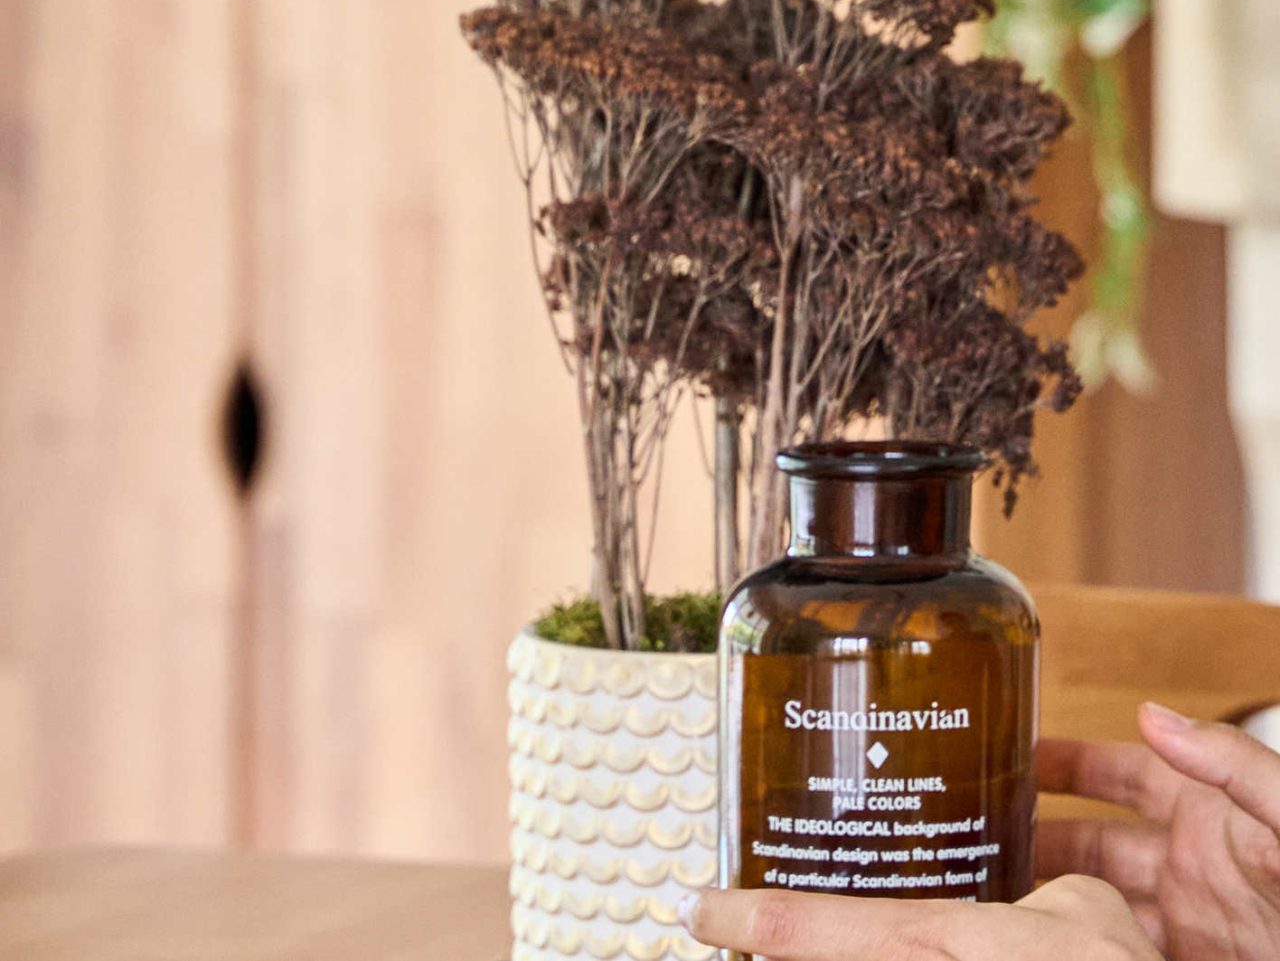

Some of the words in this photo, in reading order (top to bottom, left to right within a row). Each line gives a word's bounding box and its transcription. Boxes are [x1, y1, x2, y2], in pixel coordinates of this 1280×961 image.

[784, 700, 970, 731] Scandinavian
[808, 777, 857, 793] SIMPLE,
[862, 778, 905, 792] CLEAN
[907, 777, 947, 792] LINES,
[832, 796, 865, 811] PALE
[867, 796, 922, 811] COLORS
[767, 815, 793, 833] THE
[794, 818, 891, 837] IDEOLOGICAL
[893, 817, 971, 839] background
[972, 815, 986, 831] of
[752, 840, 830, 861] Scandinavian
[832, 847, 878, 865] design
[880, 850, 910, 863] was
[912, 846, 935, 861] the
[764, 868, 778, 883] of
[778, 872, 787, 885] a
[788, 872, 851, 888] particular
[852, 873, 943, 889] Scandinavian
[944, 870, 974, 885] form
[975, 867, 988, 882] of
